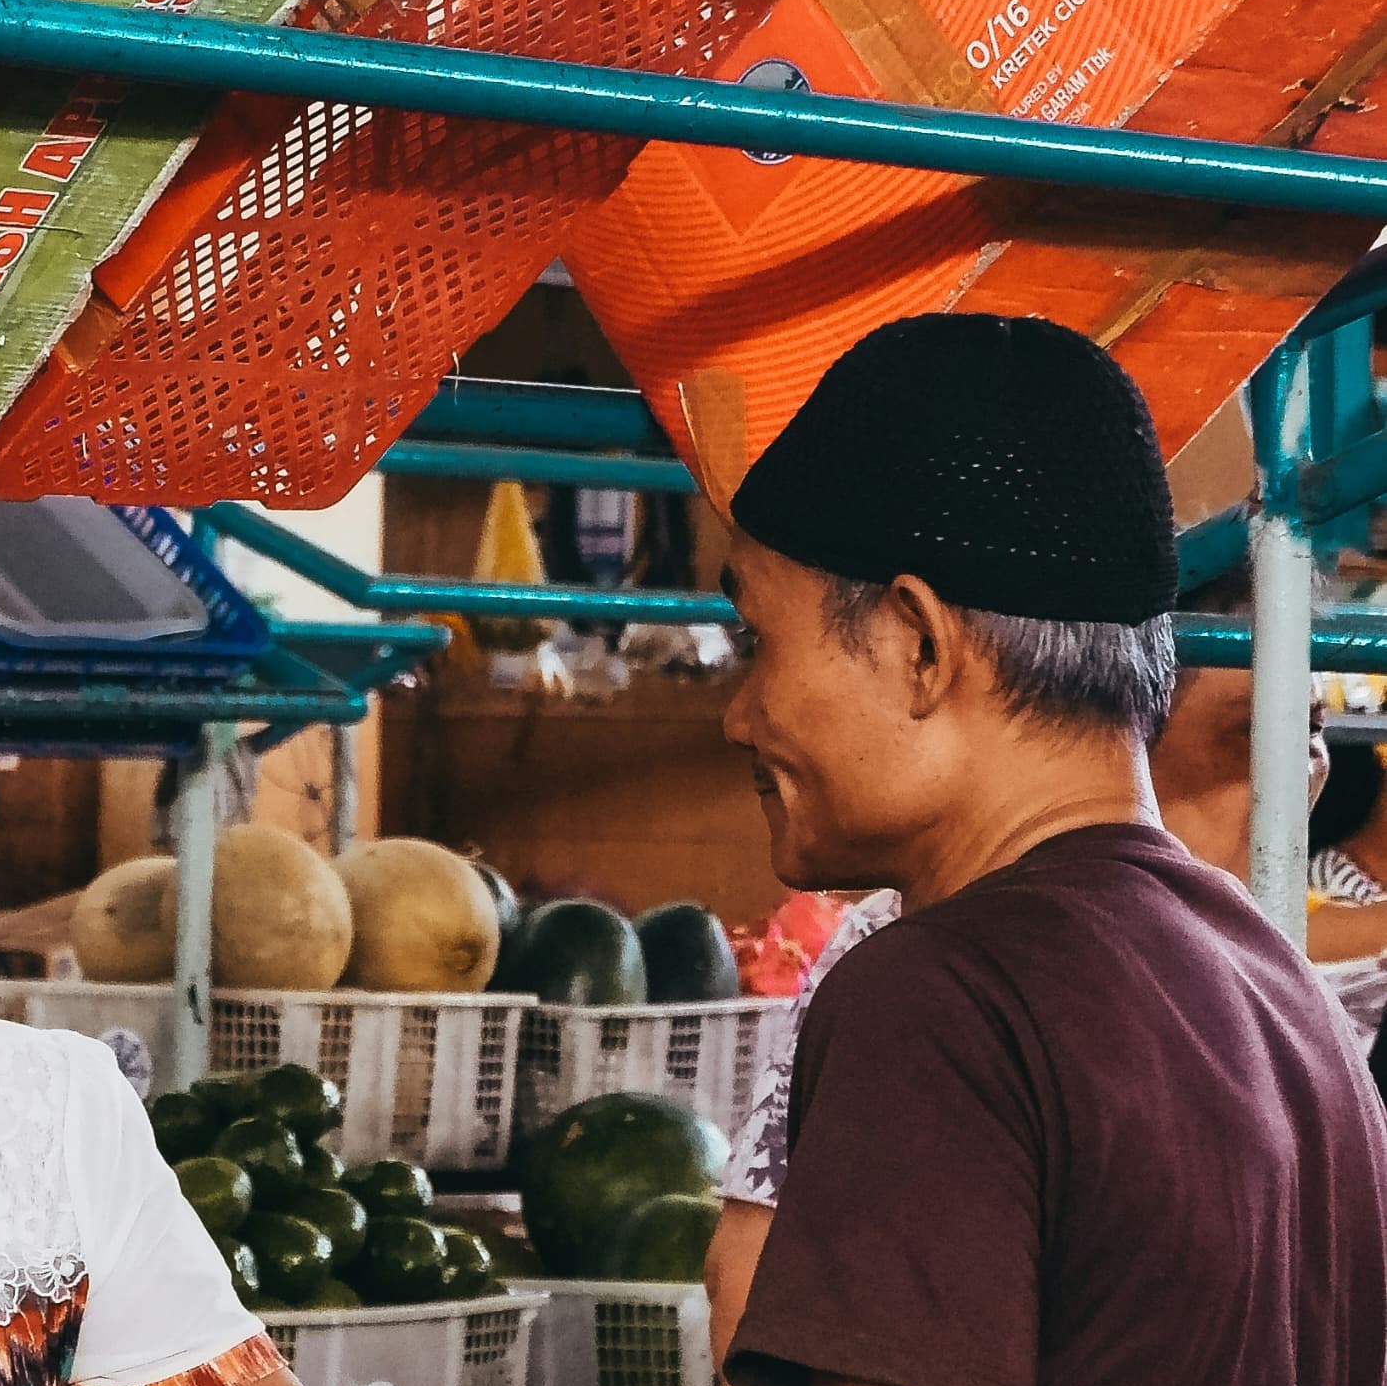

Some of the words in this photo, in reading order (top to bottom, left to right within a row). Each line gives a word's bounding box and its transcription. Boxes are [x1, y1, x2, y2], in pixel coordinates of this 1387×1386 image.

[991, 16, 1058, 90] KRETEK
[1046, 63, 1063, 85] BY
[1040, 70, 1089, 122] GARAM
